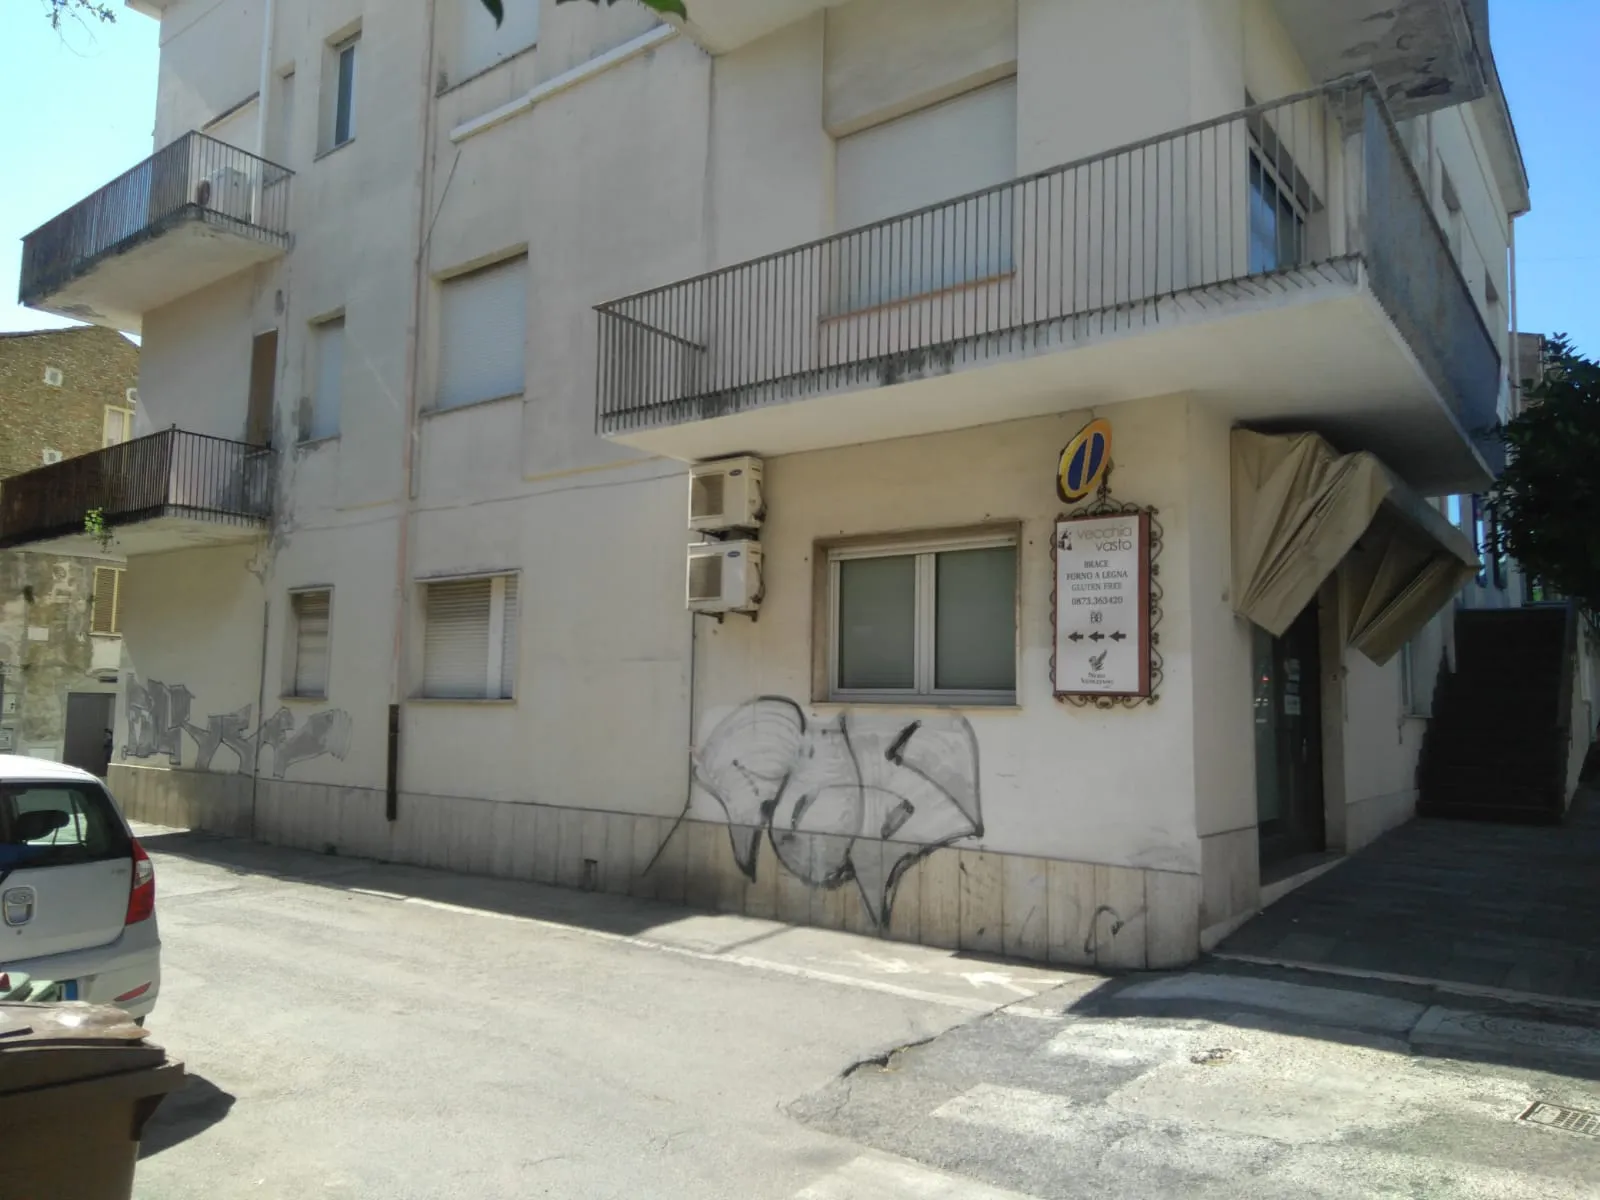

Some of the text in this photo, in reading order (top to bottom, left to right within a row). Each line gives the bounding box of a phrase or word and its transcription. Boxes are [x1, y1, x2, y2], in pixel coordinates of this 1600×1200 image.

[1077, 524, 1132, 540] vecchia
[1095, 537, 1132, 552] vasto
[1083, 560, 1109, 569] BRACE
[1066, 569, 1129, 581] FORNO A LEGNA
[1071, 582, 1123, 592] GLUTEN FREE
